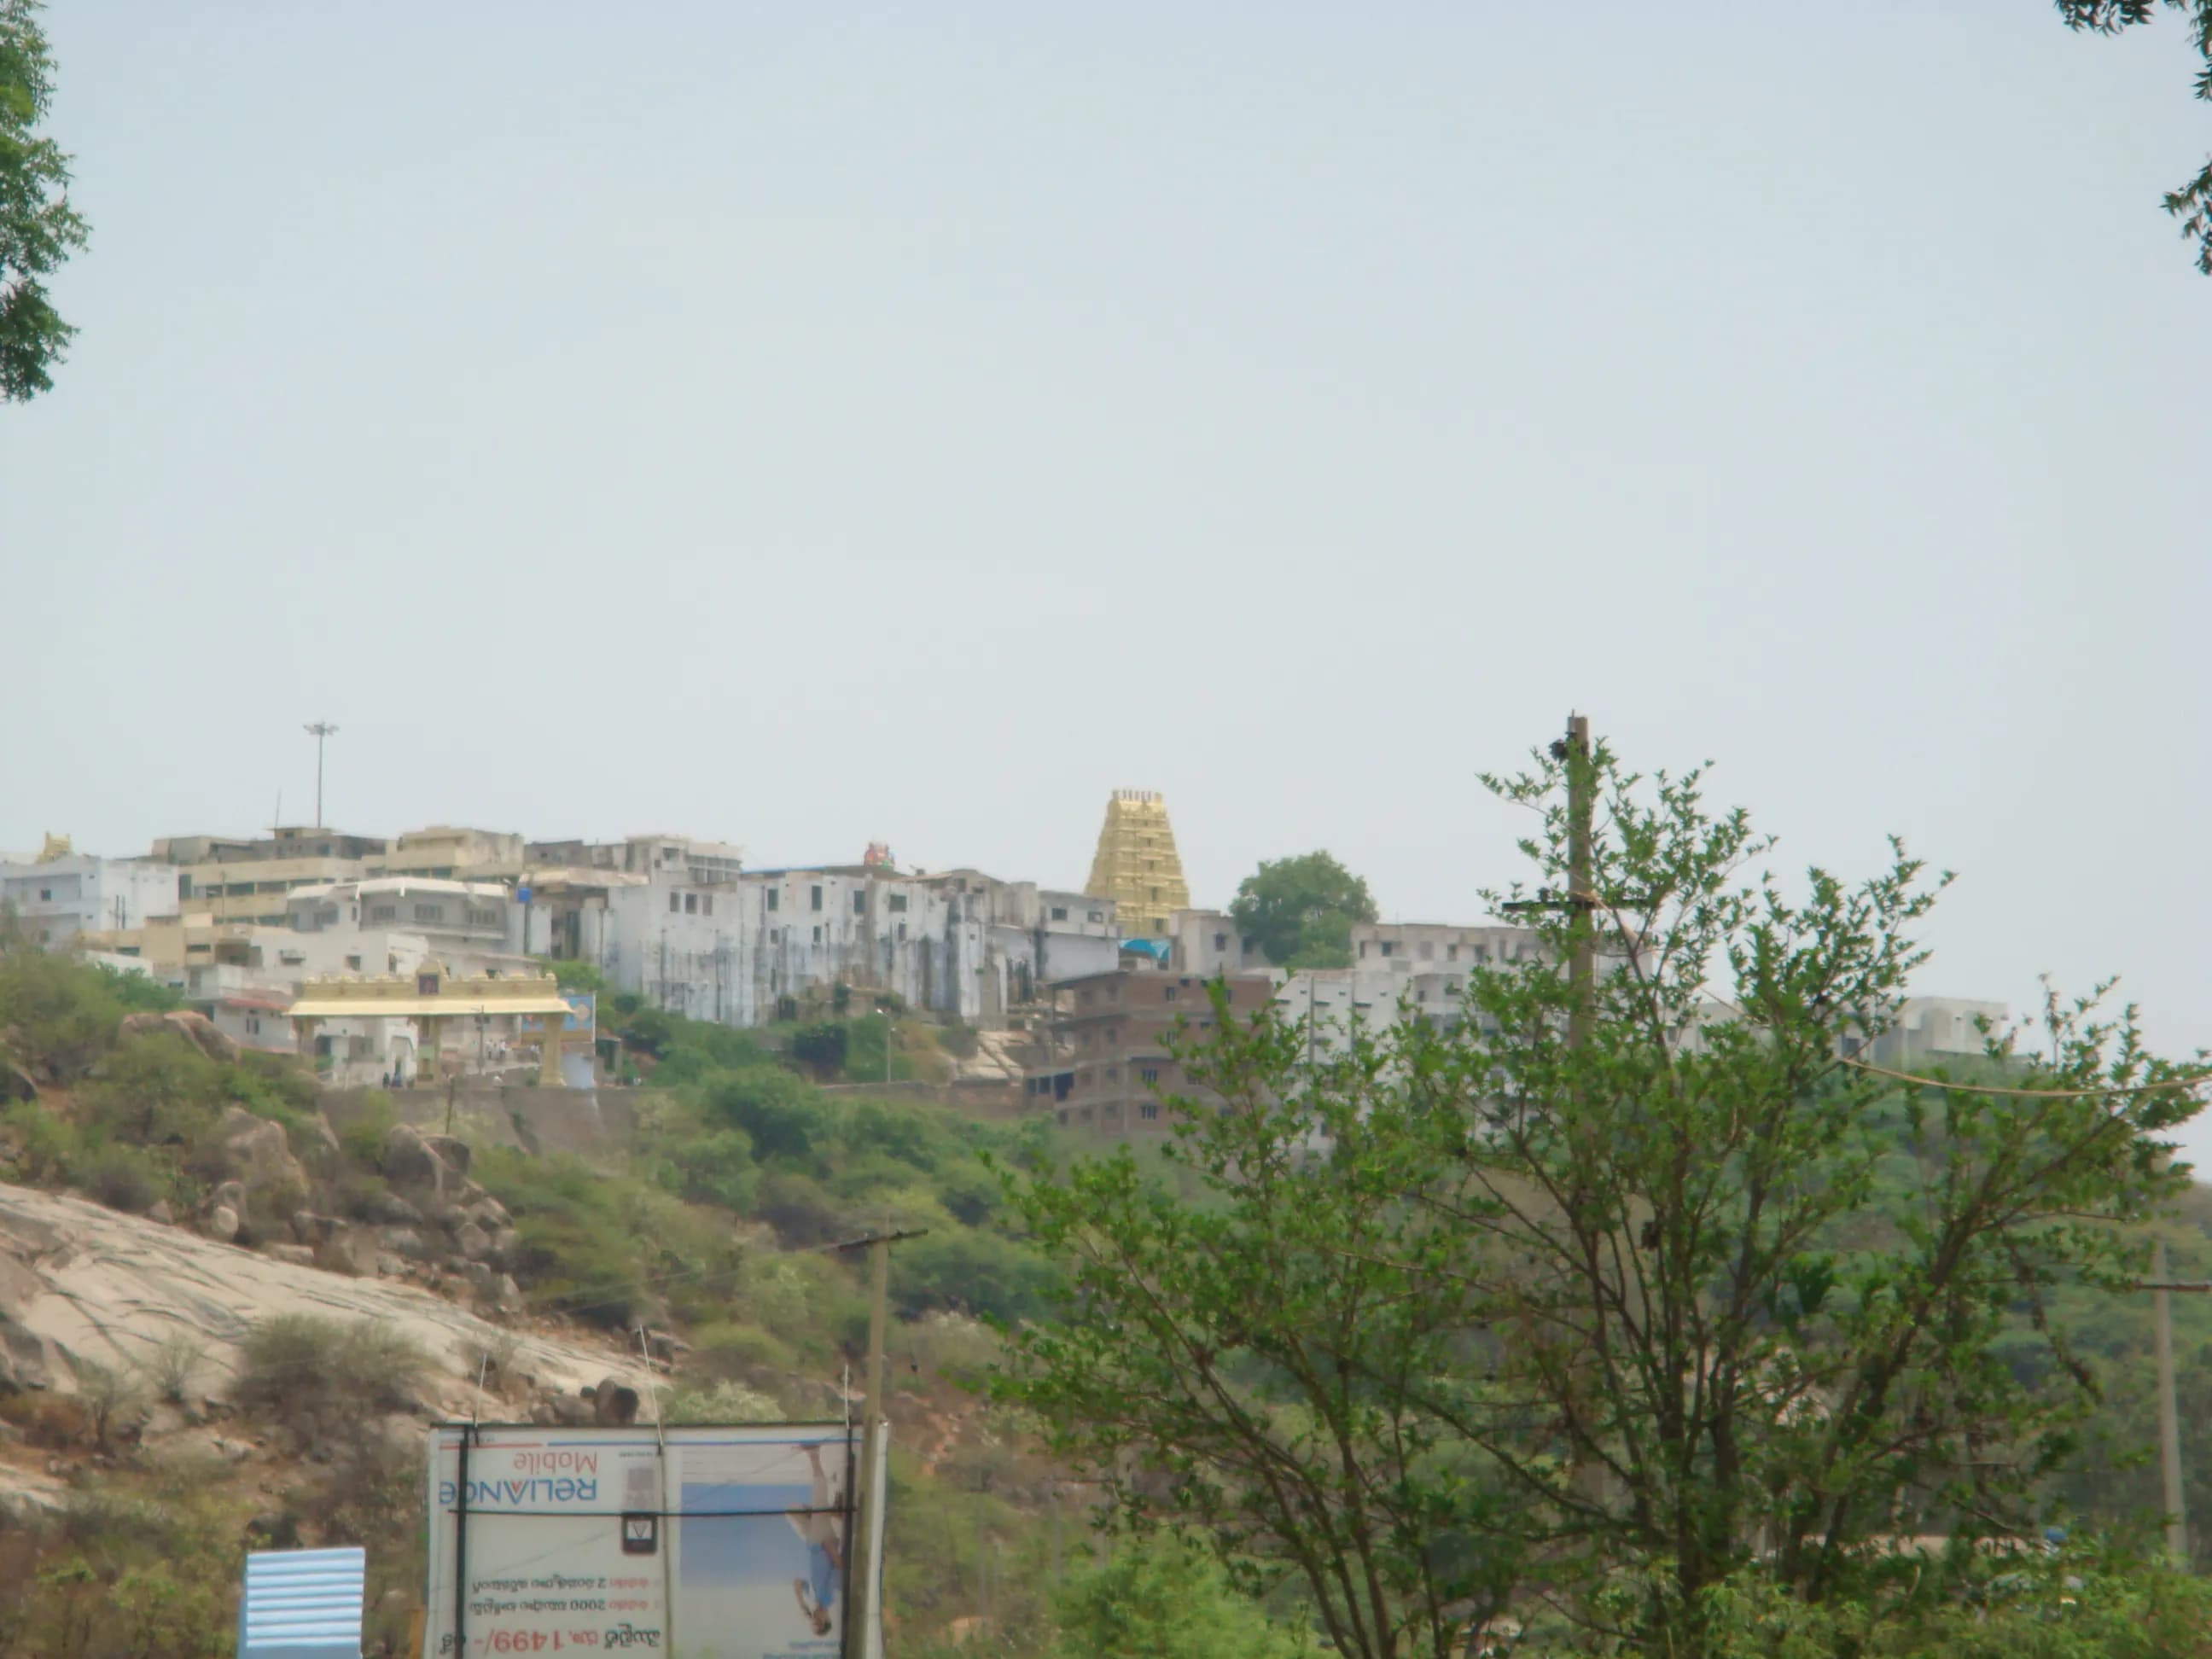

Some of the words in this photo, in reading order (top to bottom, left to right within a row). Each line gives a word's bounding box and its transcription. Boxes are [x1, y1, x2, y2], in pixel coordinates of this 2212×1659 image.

[513, 1452, 597, 1475] Mobile
[598, 1578, 606, 1590] 2
[570, 1600, 606, 1610] 2000
